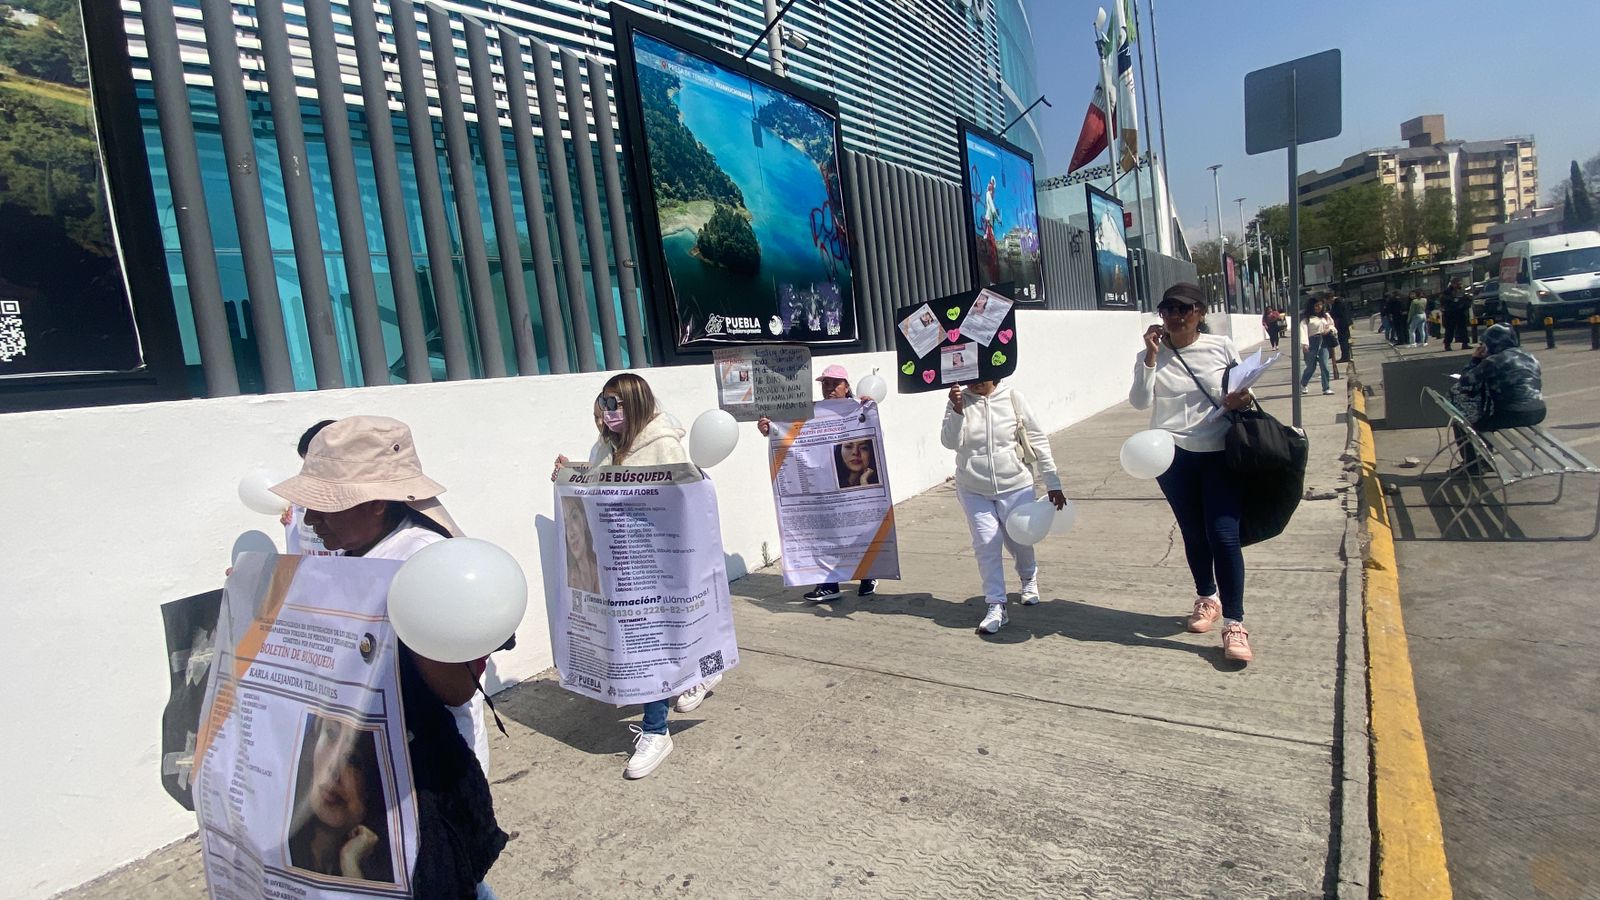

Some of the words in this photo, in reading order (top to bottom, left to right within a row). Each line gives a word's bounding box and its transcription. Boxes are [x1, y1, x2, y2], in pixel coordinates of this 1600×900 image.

[1353, 265, 1379, 276] dico
[726, 317, 761, 328] PUEBLA
[614, 470, 673, 483] BÚSQUEDA
[663, 587, 710, 604] ¡Llámanos!
[260, 642, 289, 658] BOLETÍN
[291, 648, 301, 660] DE
[301, 649, 335, 670] BÚSQUEDA
[249, 667, 268, 680] KARLA
[270, 672, 303, 688] ALEJANDRA
[305, 680, 317, 692] TELA
[578, 675, 602, 689] PUEBLA
